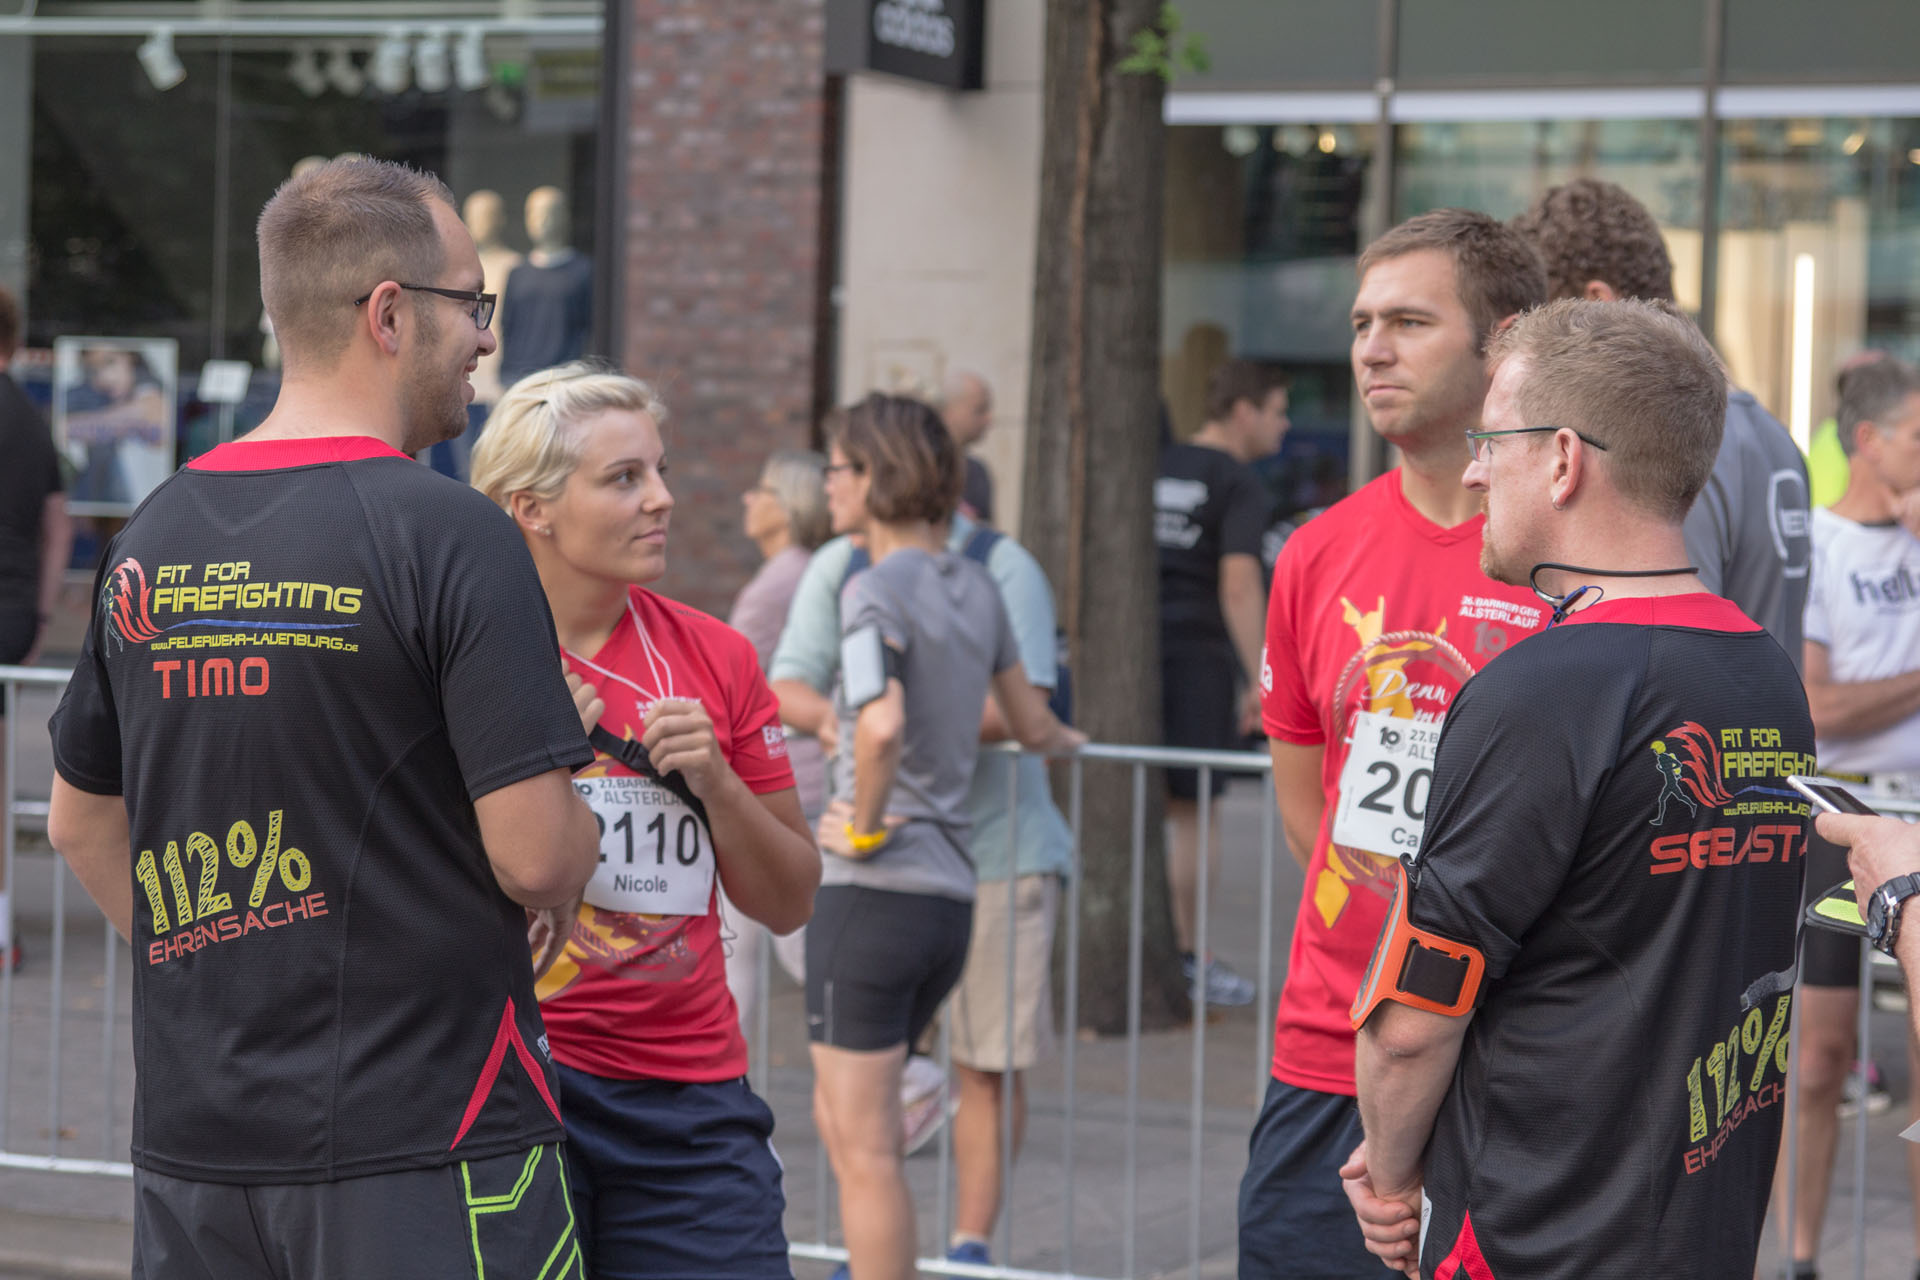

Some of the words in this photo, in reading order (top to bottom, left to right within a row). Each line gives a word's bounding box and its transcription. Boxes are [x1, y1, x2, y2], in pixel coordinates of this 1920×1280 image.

[156, 564, 192, 585] FIT
[203, 561, 251, 583] FOR
[153, 581, 363, 614] FIREFIGHTING
[1458, 605, 1540, 630] ALSTERLAUF
[153, 656, 270, 699] TIMO
[1721, 729, 1744, 749] FIT
[1750, 728, 1782, 749] FOR
[135, 809, 312, 936] 112%
[613, 873, 668, 893] Nicole
[149, 891, 329, 966] EHRENSACHE
[1687, 995, 1790, 1143] 112%
